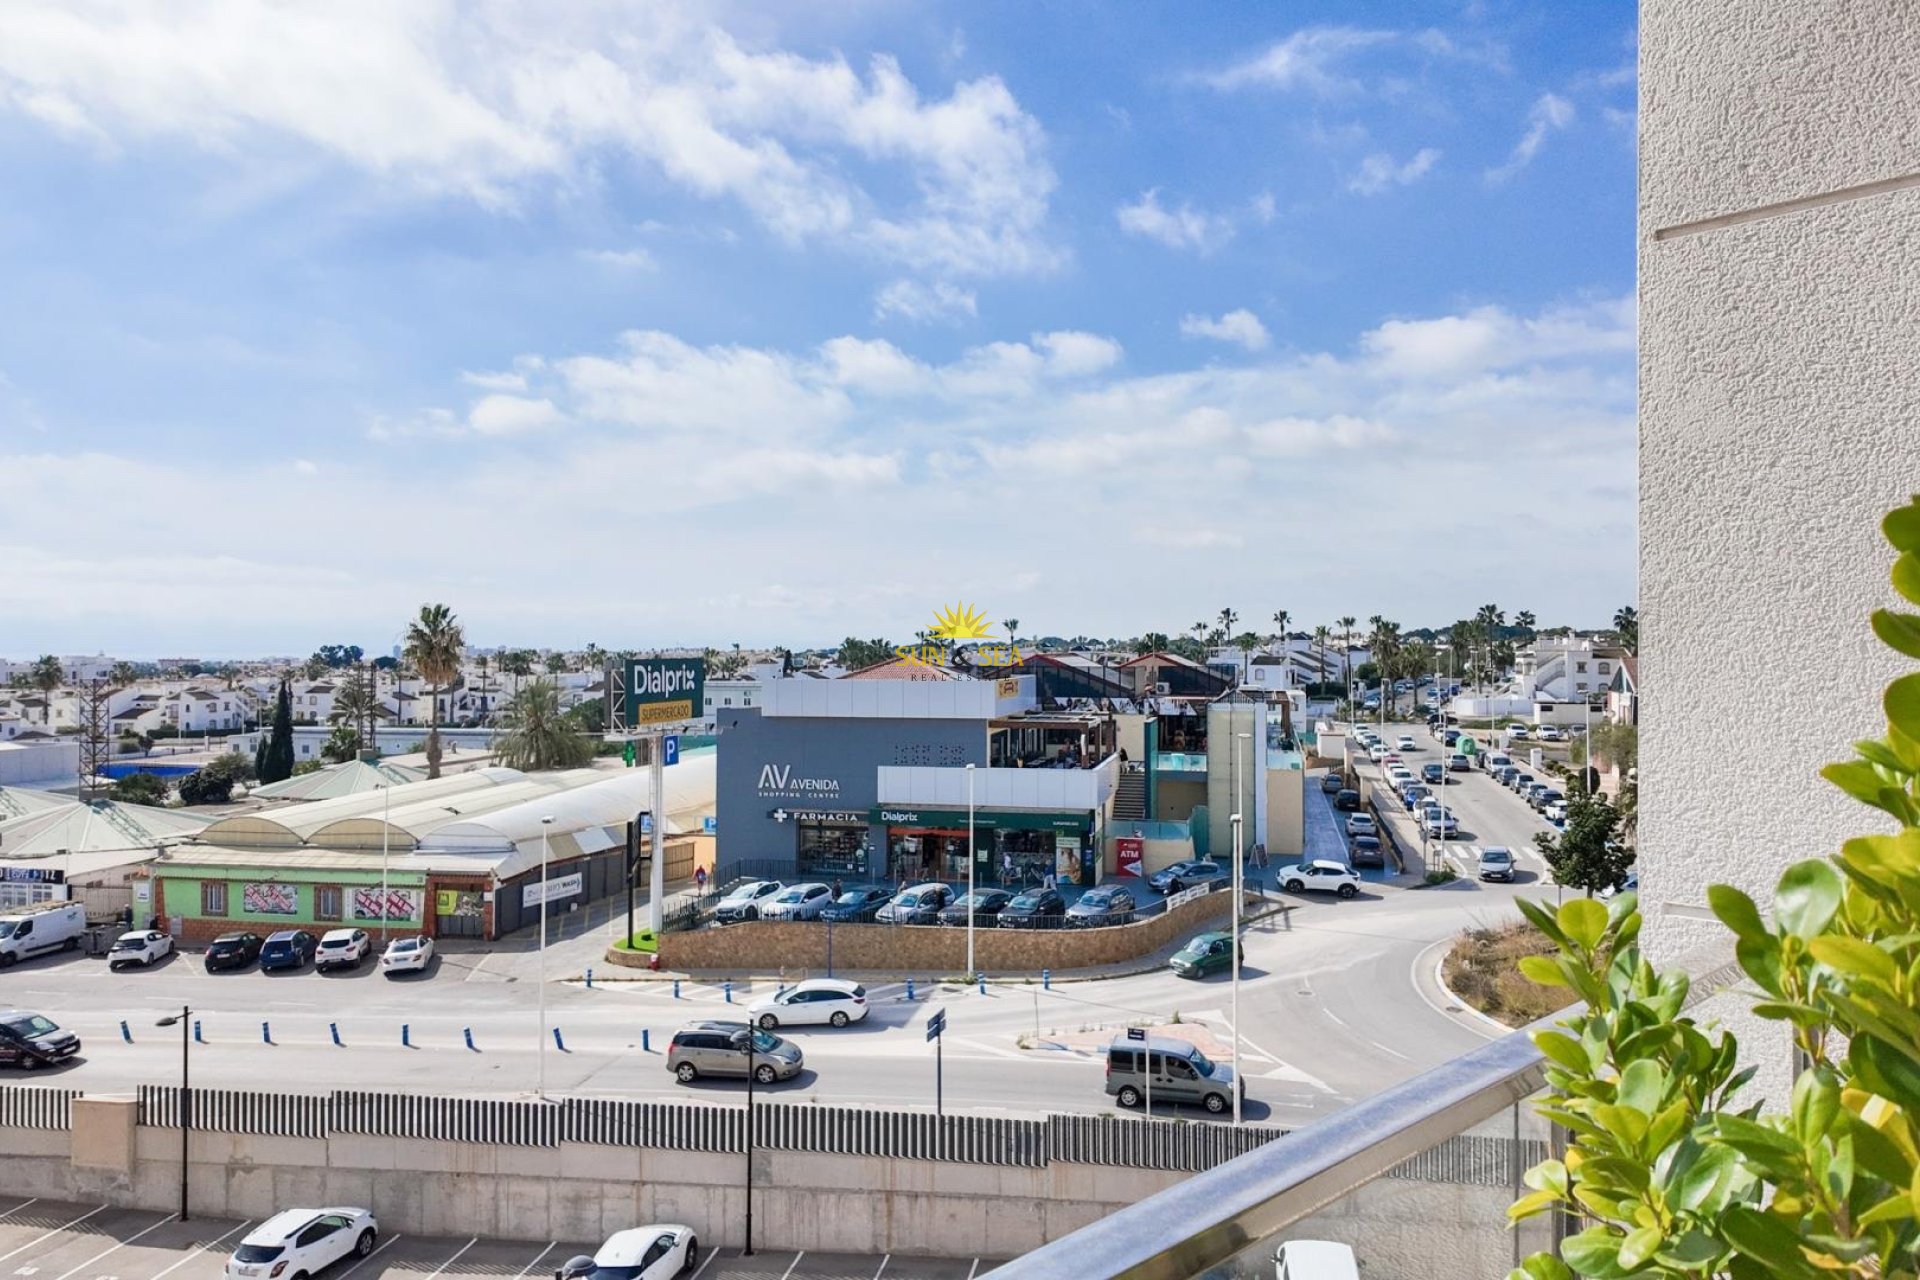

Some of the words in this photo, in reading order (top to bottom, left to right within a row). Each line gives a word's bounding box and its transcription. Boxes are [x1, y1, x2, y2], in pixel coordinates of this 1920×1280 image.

[634, 664, 695, 698] Dialprix
[642, 703, 689, 721] SUPERMERCADO
[667, 740, 675, 762] P
[758, 764, 791, 789] AV
[790, 779, 840, 790] AVENIDA
[794, 812, 858, 822] FARMACIA
[881, 811, 918, 822] Dialprix
[1120, 850, 1139, 858] ATM
